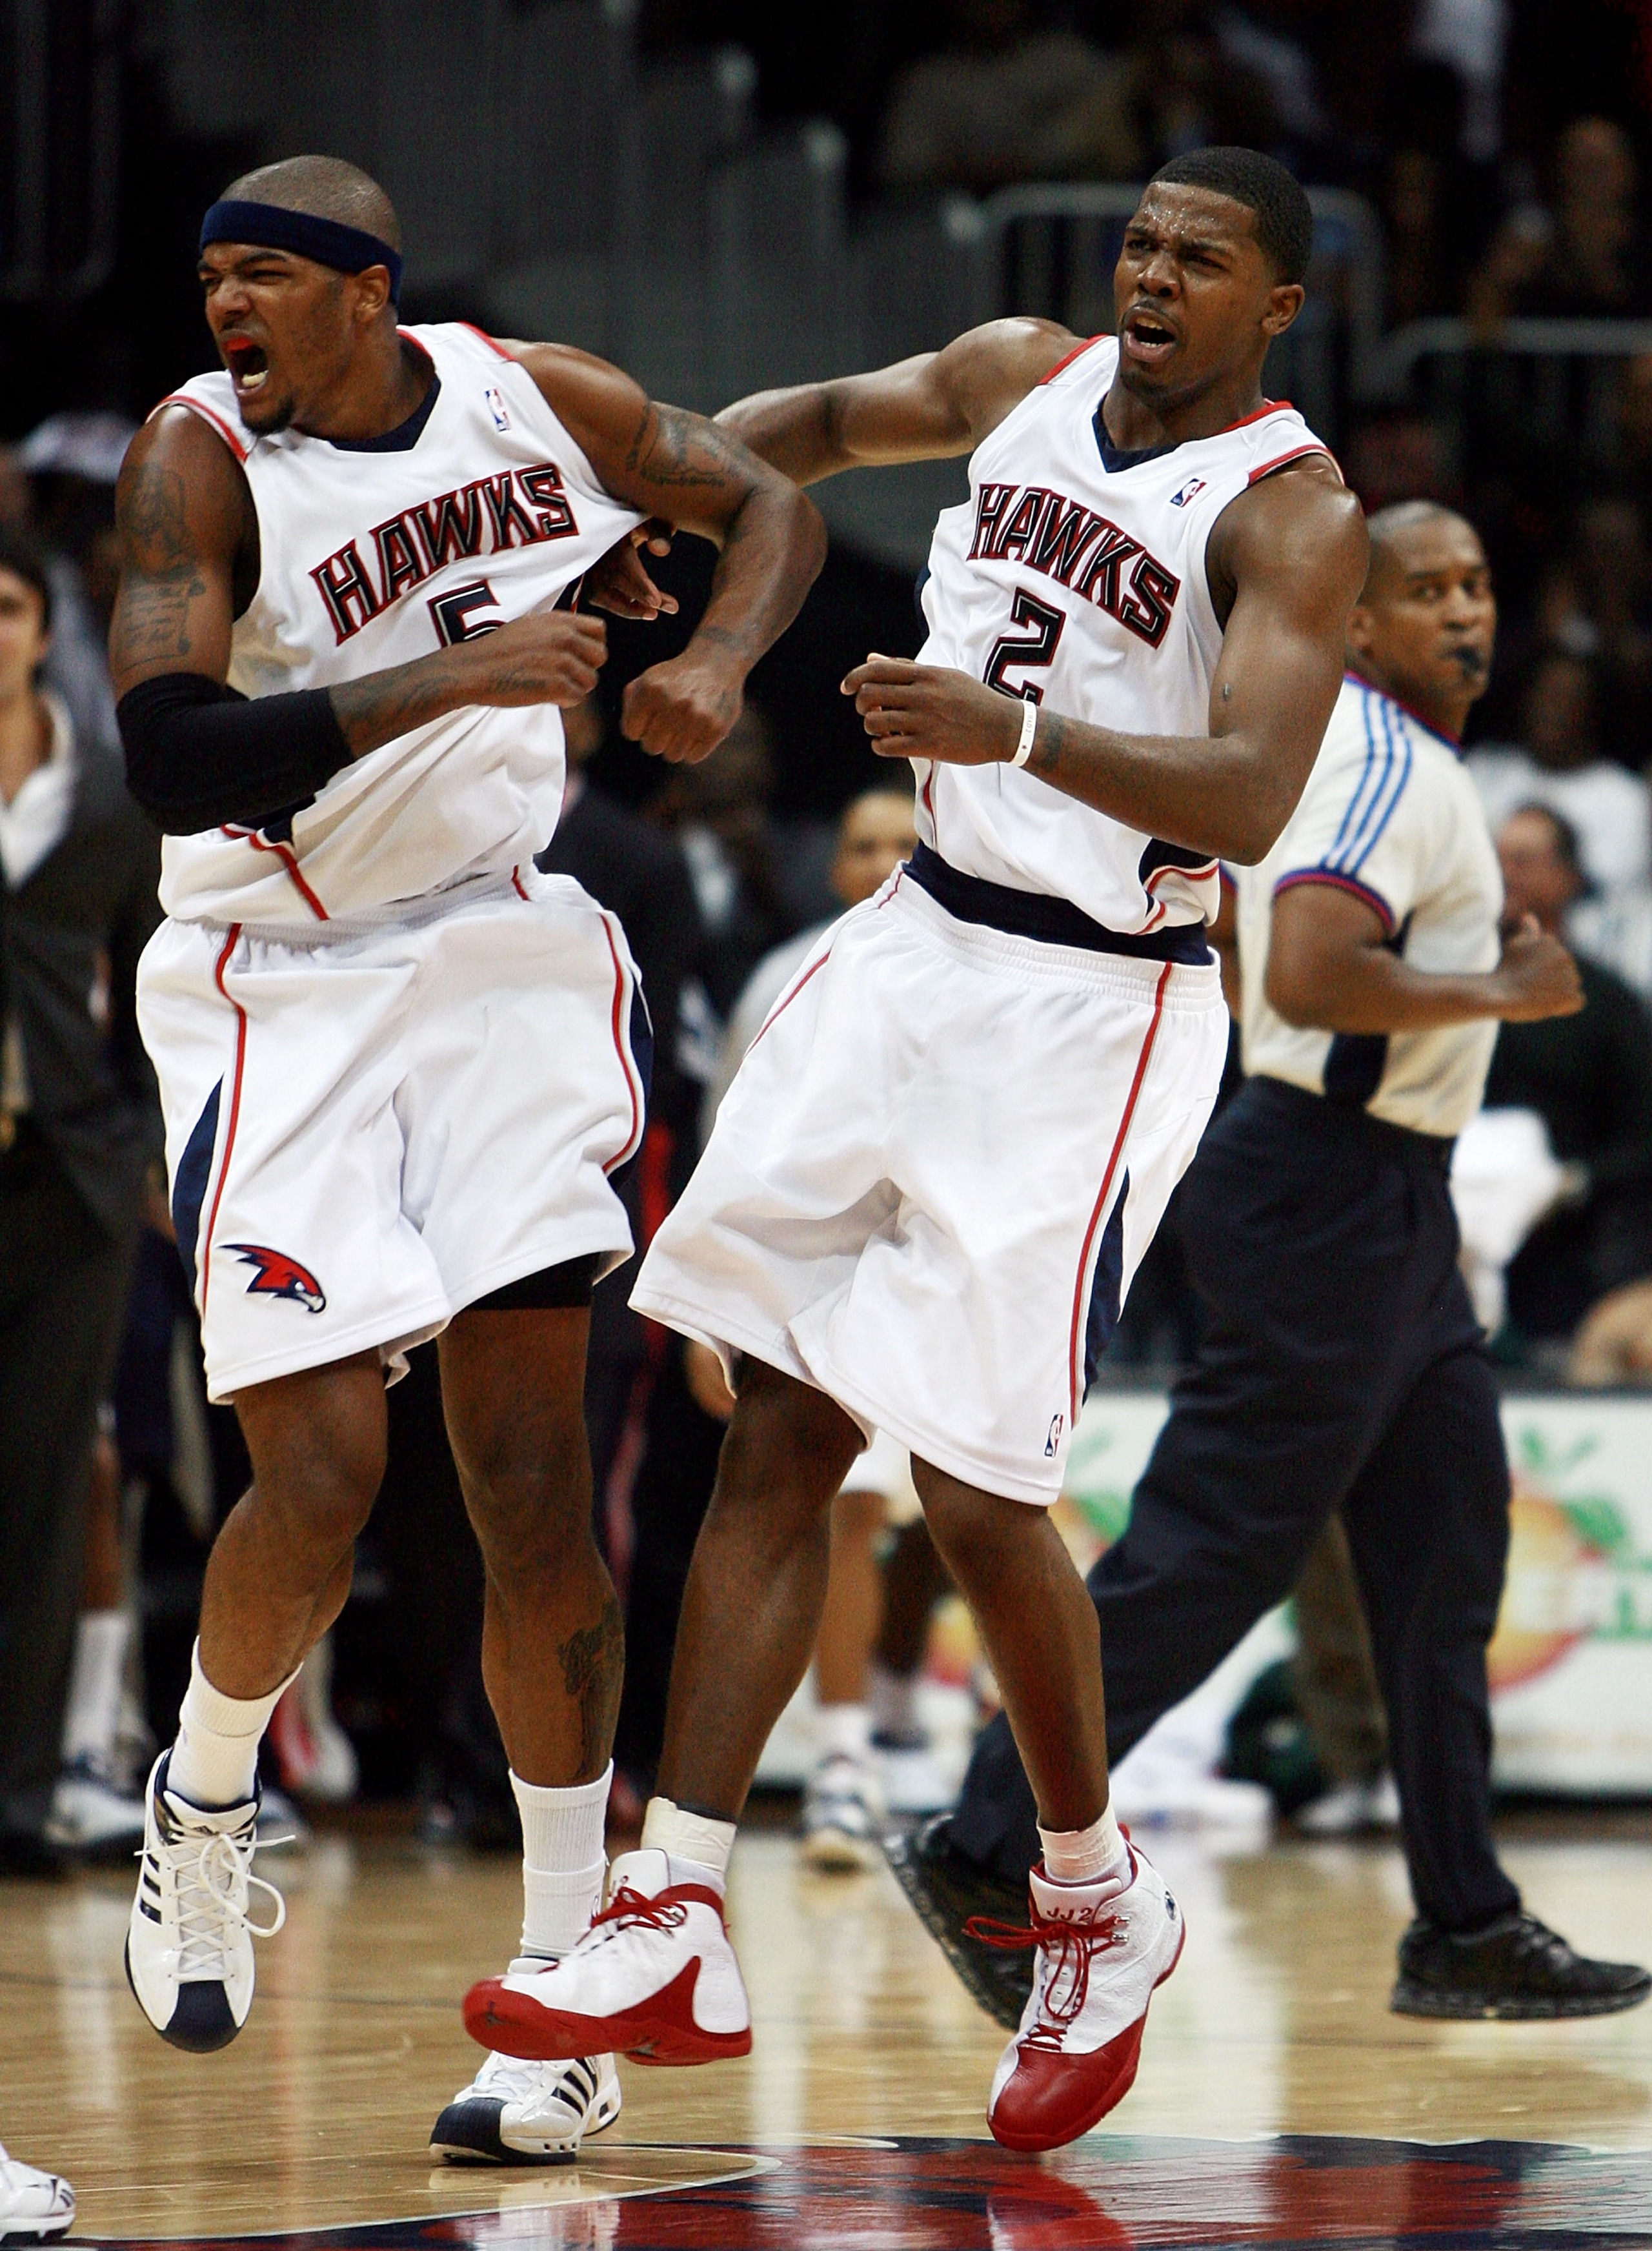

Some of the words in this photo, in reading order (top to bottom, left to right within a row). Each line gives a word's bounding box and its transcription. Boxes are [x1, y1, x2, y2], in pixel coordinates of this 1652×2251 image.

[308, 463, 580, 647] HAWKS
[966, 483, 1181, 650] HAWKS
[983, 587, 1066, 707] 2
